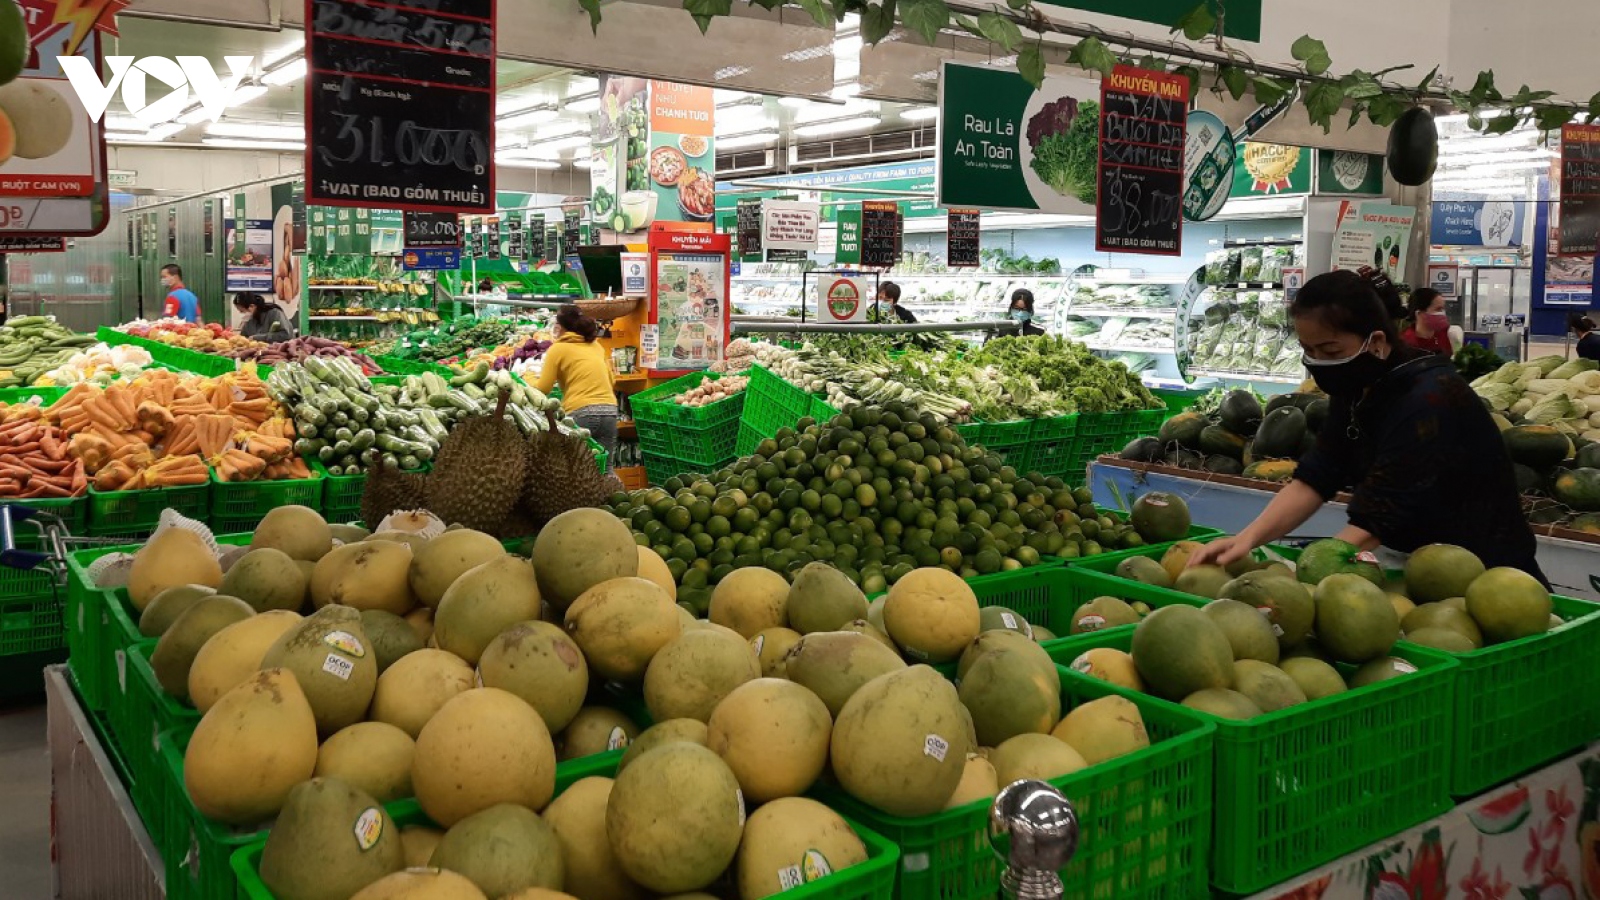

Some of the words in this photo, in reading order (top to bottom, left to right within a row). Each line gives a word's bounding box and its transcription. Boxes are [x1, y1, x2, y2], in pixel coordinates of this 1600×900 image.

[1110, 73, 1157, 93] KHUYẾN
[1160, 80, 1182, 97] MÃI
[655, 107, 688, 120] CHANH
[964, 114, 992, 134] Rau
[996, 118, 1014, 136] Lá
[954, 138, 976, 157] An
[1251, 144, 1292, 158] HACCP
[474, 164, 486, 175] Đ
[889, 169, 907, 178] FARM
[908, 168, 917, 176] TO
[917, 166, 934, 175] FORK
[33, 181, 57, 190] CAM
[59, 182, 81, 191] (VN)
[363, 184, 400, 198] (BAO
[411, 220, 460, 237] 38.000
[842, 222, 858, 231] RAU
